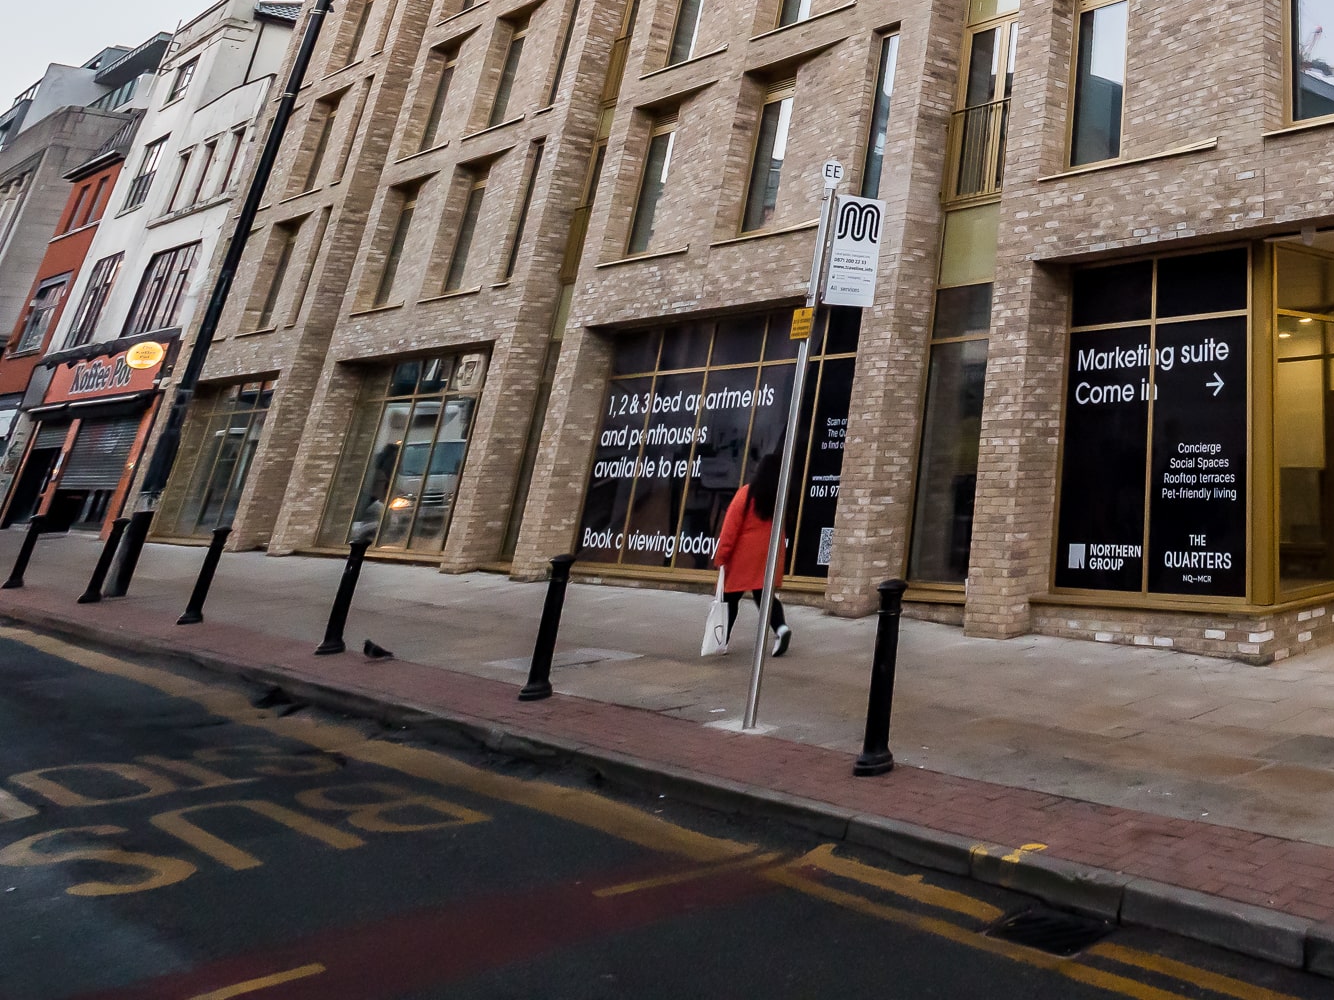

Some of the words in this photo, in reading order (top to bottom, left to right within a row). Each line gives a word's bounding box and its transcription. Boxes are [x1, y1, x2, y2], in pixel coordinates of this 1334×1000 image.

[825, 164, 842, 179] EE
[1077, 343, 1175, 372] Marketing
[1180, 337, 1230, 364] suite
[68, 360, 112, 395] Koffee
[1075, 381, 1135, 405] Come
[1140, 377, 1158, 401] in
[608, 395, 616, 418] 1,
[618, 395, 628, 415] 2
[629, 393, 640, 414] &
[641, 392, 651, 414] 3
[652, 390, 683, 414] bed
[685, 383, 775, 416] apartments
[826, 417, 841, 427] Scan
[600, 424, 628, 447] and
[628, 423, 708, 450] penthouses
[828, 428, 839, 438] The
[821, 441, 828, 450] to
[828, 440, 840, 449] find
[1177, 442, 1222, 455] Concierge
[594, 456, 655, 478] available
[658, 455, 672, 478] to
[673, 454, 702, 478] rent.
[1169, 457, 1196, 469] Social
[1197, 456, 1230, 471] Spaces
[1163, 471, 1197, 486] Rooftop
[1199, 472, 1236, 484] terraces
[810, 485, 828, 498] 0161
[1161, 486, 1212, 501] Pet-friendly
[1213, 486, 1237, 501] living
[582, 527, 611, 549] Book
[628, 529, 677, 558] viewing
[1188, 534, 1207, 547] THE
[1089, 543, 1142, 558] NORTHERN
[1089, 557, 1124, 571] GROUP
[1164, 550, 1233, 570] QUARTERS
[0, 745, 346, 822] STO
[0, 783, 492, 897] BUS
